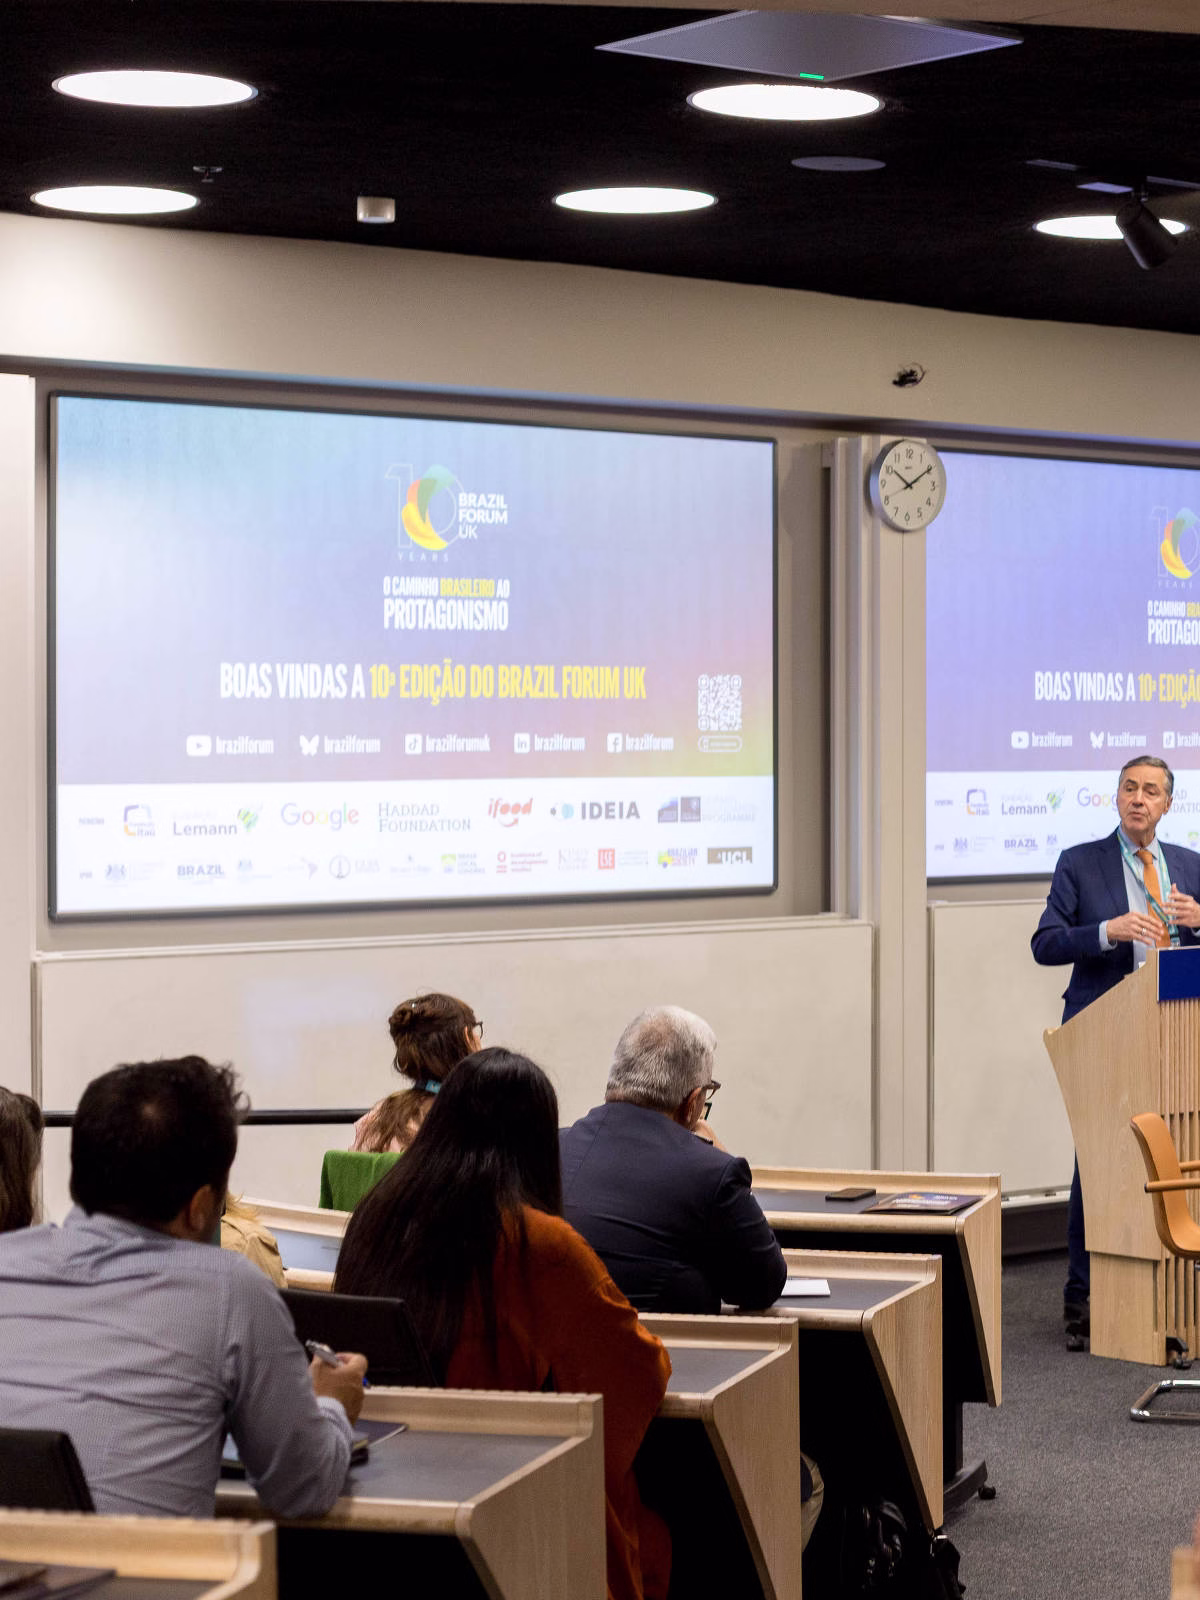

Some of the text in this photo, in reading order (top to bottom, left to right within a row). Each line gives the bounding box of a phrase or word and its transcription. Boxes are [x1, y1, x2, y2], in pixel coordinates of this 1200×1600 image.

[894, 453, 901, 464] 11
[906, 448, 914, 459] 12
[886, 465, 894, 475] 10
[930, 480, 936, 491] 3
[458, 493, 508, 509] BRAZIL
[458, 509, 508, 524] FORUM
[458, 525, 478, 539] UK
[383, 576, 391, 596] O
[392, 577, 439, 597] CAMINHO
[496, 579, 510, 599] AO
[383, 599, 509, 631] PROTAGONISMO
[220, 662, 272, 699] BOAS
[275, 662, 348, 699] VINDAS
[351, 663, 365, 699] A
[400, 658, 466, 706] EDIÇÃO
[470, 665, 494, 699] DO
[498, 665, 559, 699] BRAZIL
[562, 666, 620, 699] FORUM
[623, 666, 647, 699] UK
[1034, 671, 1072, 701] BOAS
[1073, 671, 1123, 701] VINDAS
[1126, 672, 1136, 702] A
[216, 735, 274, 754] brazilforum
[324, 735, 381, 753] brazilforum
[425, 733, 491, 752] brazilforumuk
[534, 733, 586, 751] brazilforum
[626, 733, 674, 751] brazilforum
[281, 802, 360, 832] Google
[581, 801, 640, 820] IDEIA
[1001, 802, 1048, 816] Lemann
[173, 821, 238, 837] Lemann
[379, 818, 471, 833] FOUNDATION
[1004, 838, 1039, 849] BRAZIL
[177, 864, 225, 877] BRAZIL
